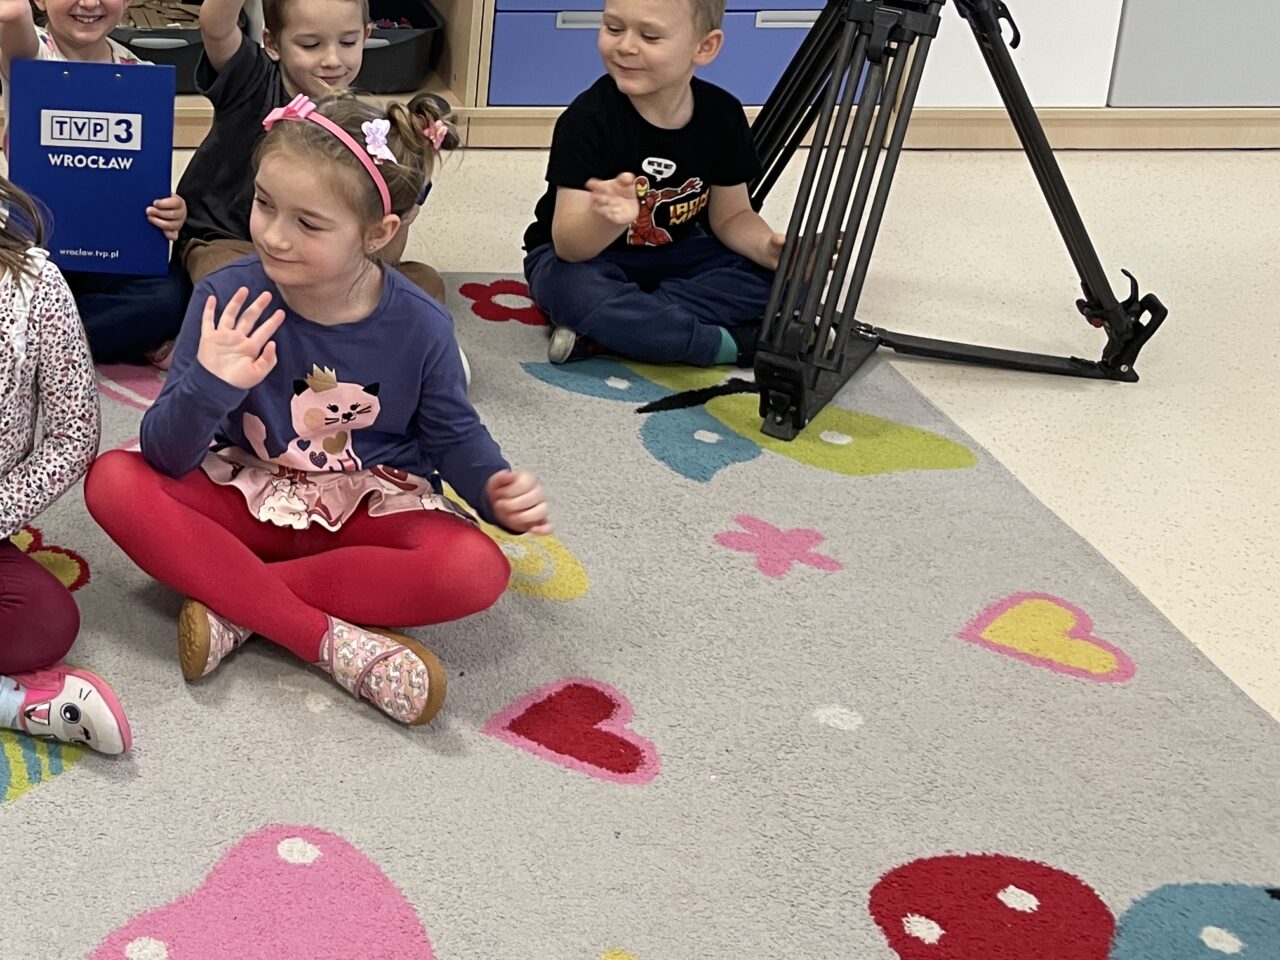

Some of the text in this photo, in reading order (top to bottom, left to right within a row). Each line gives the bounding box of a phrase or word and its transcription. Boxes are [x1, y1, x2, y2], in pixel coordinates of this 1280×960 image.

[55, 119, 134, 144] TVP 3
[48, 153, 133, 170] WROCŁAW
[59, 247, 120, 259] wroclaw.tvp.pl
